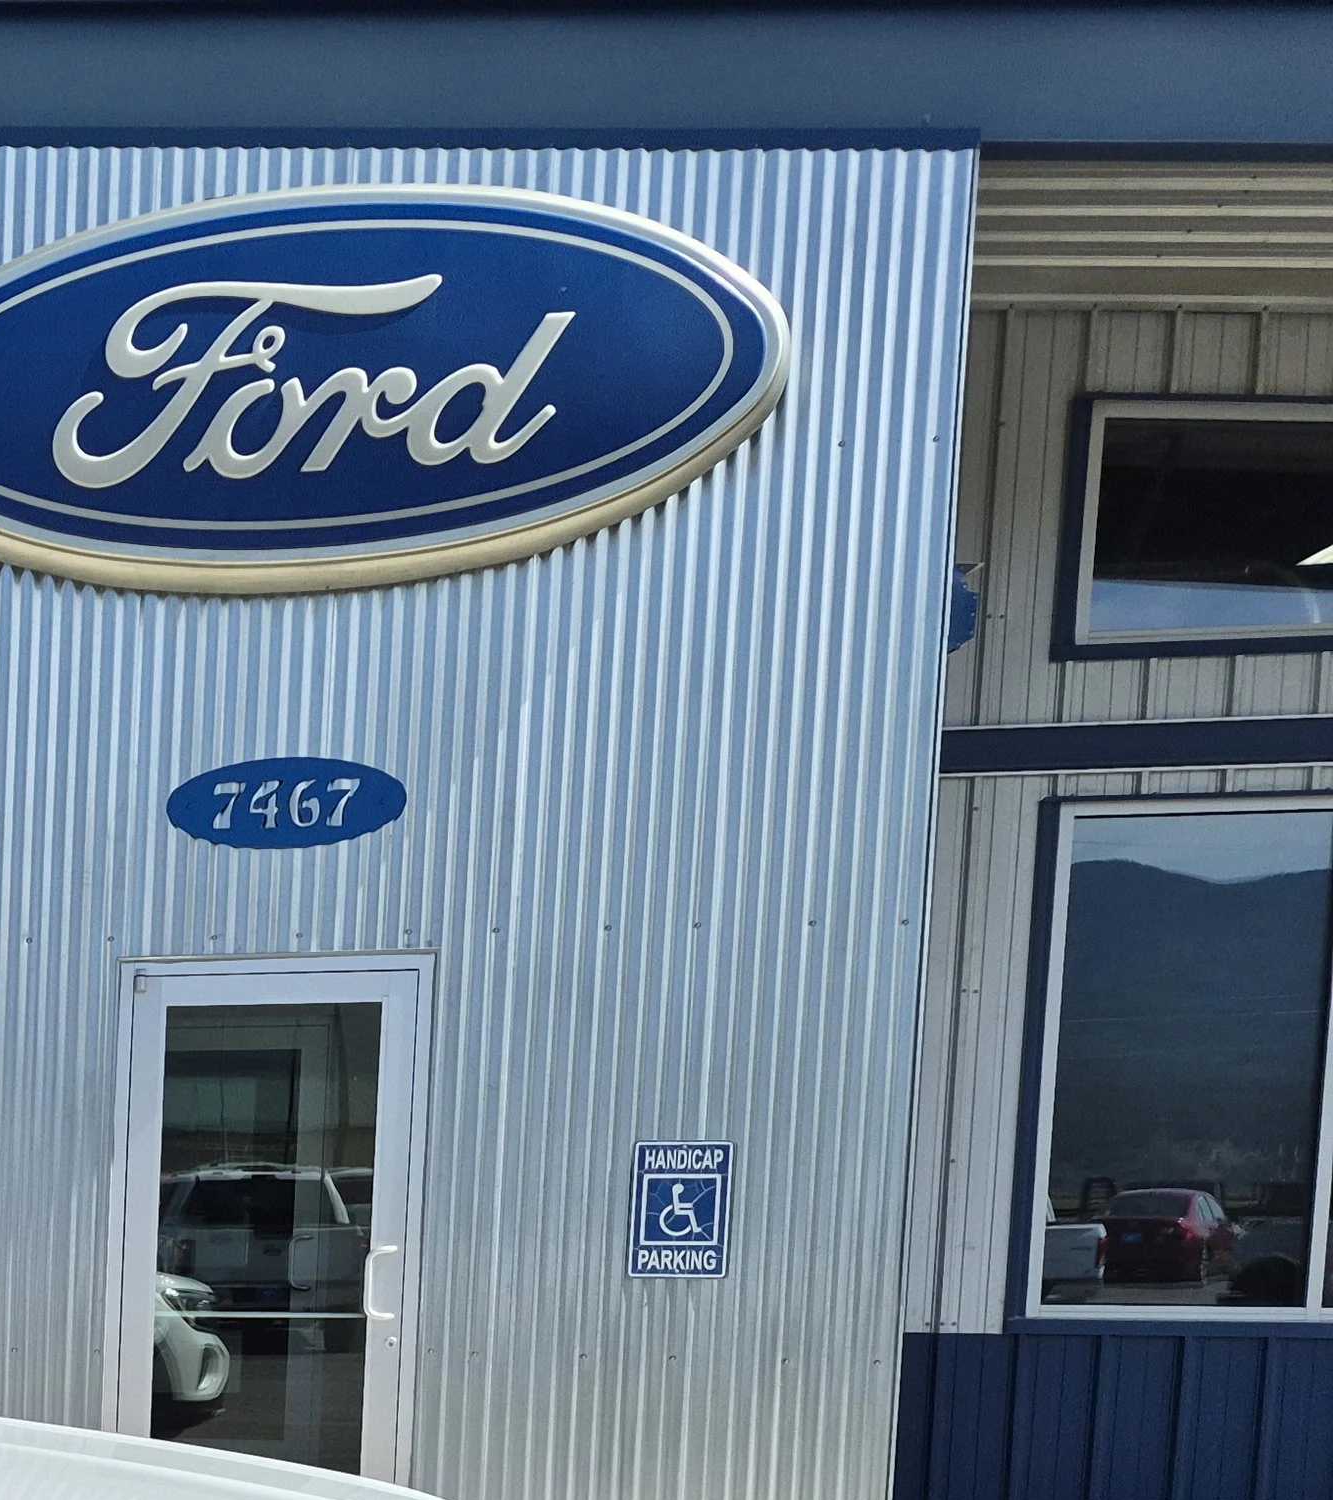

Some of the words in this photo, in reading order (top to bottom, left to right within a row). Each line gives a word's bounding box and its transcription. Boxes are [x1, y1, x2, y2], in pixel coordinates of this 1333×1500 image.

[52, 272, 577, 490] Ford
[210, 776, 361, 829] 7467
[644, 1148, 724, 1170] HANDICAP
[637, 1249, 717, 1272] PARKING
